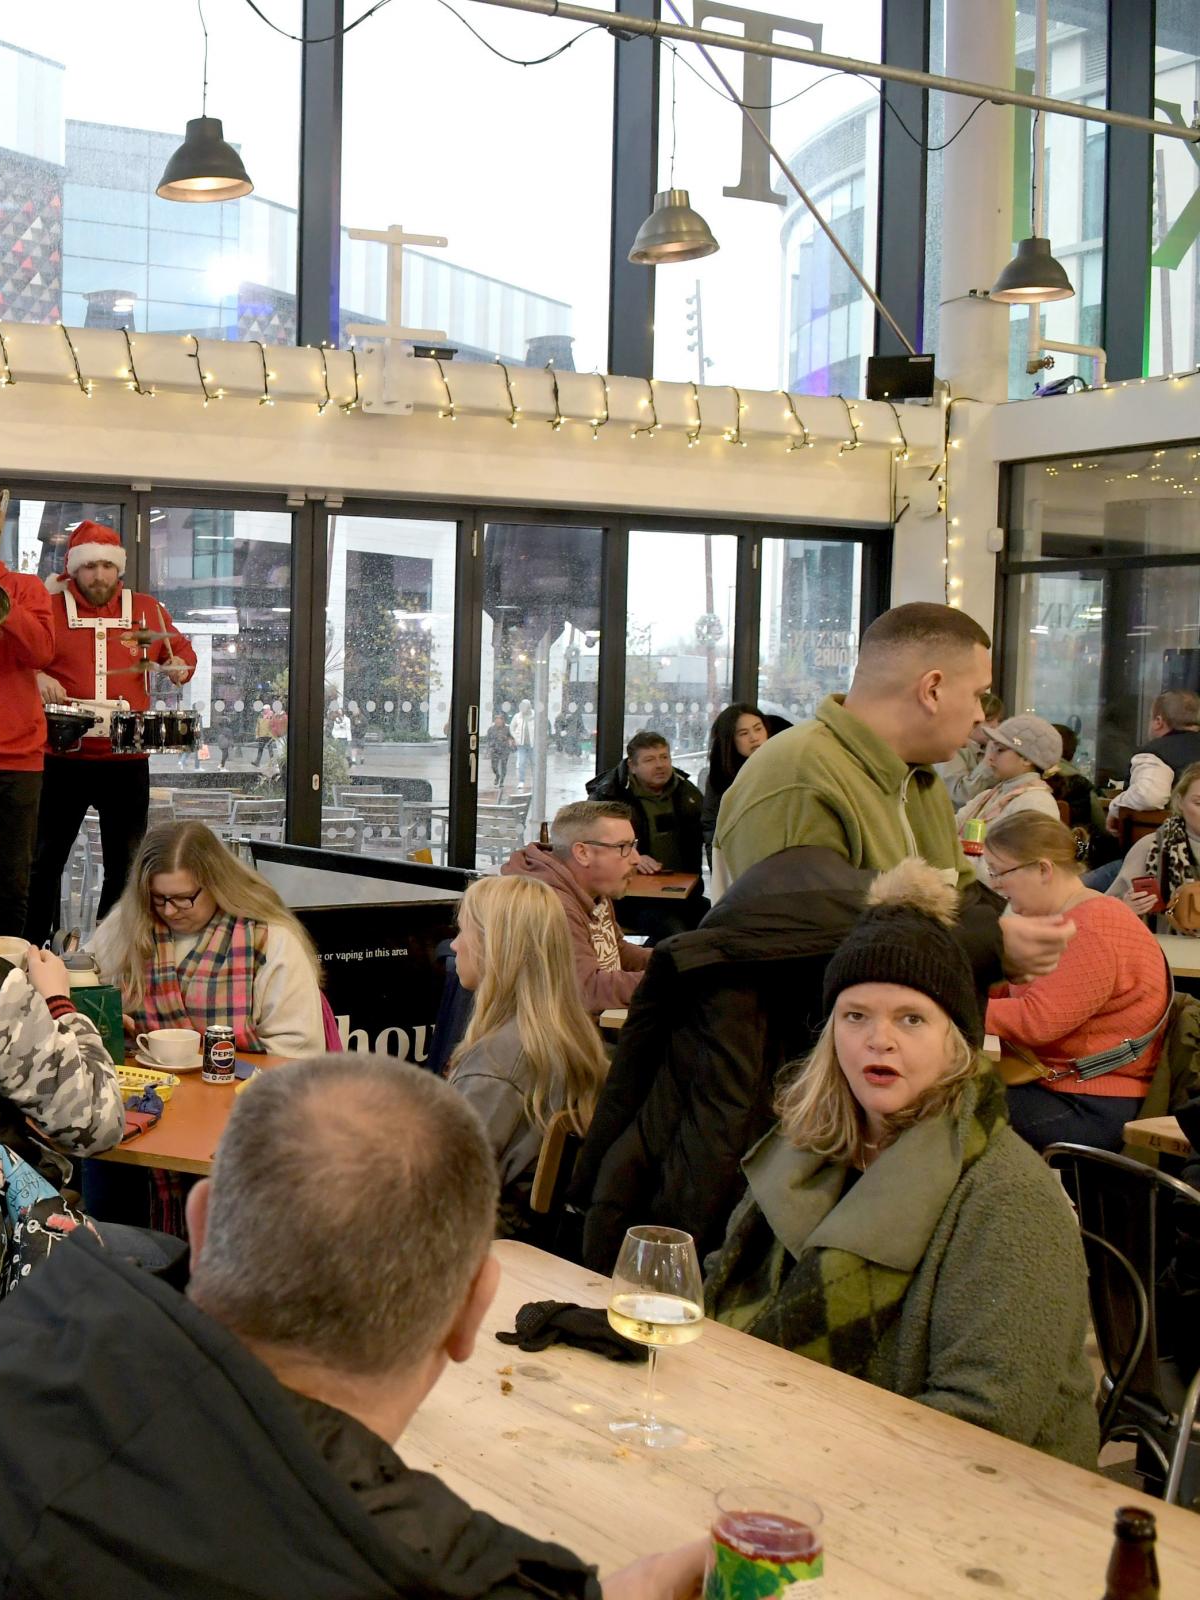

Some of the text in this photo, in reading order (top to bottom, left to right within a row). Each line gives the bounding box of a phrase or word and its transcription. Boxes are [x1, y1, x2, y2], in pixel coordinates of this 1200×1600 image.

[324, 953, 334, 961] or
[336, 949, 363, 963] vaping
[366, 948, 373, 959] in
[375, 947, 389, 958] this
[391, 948, 408, 956] area
